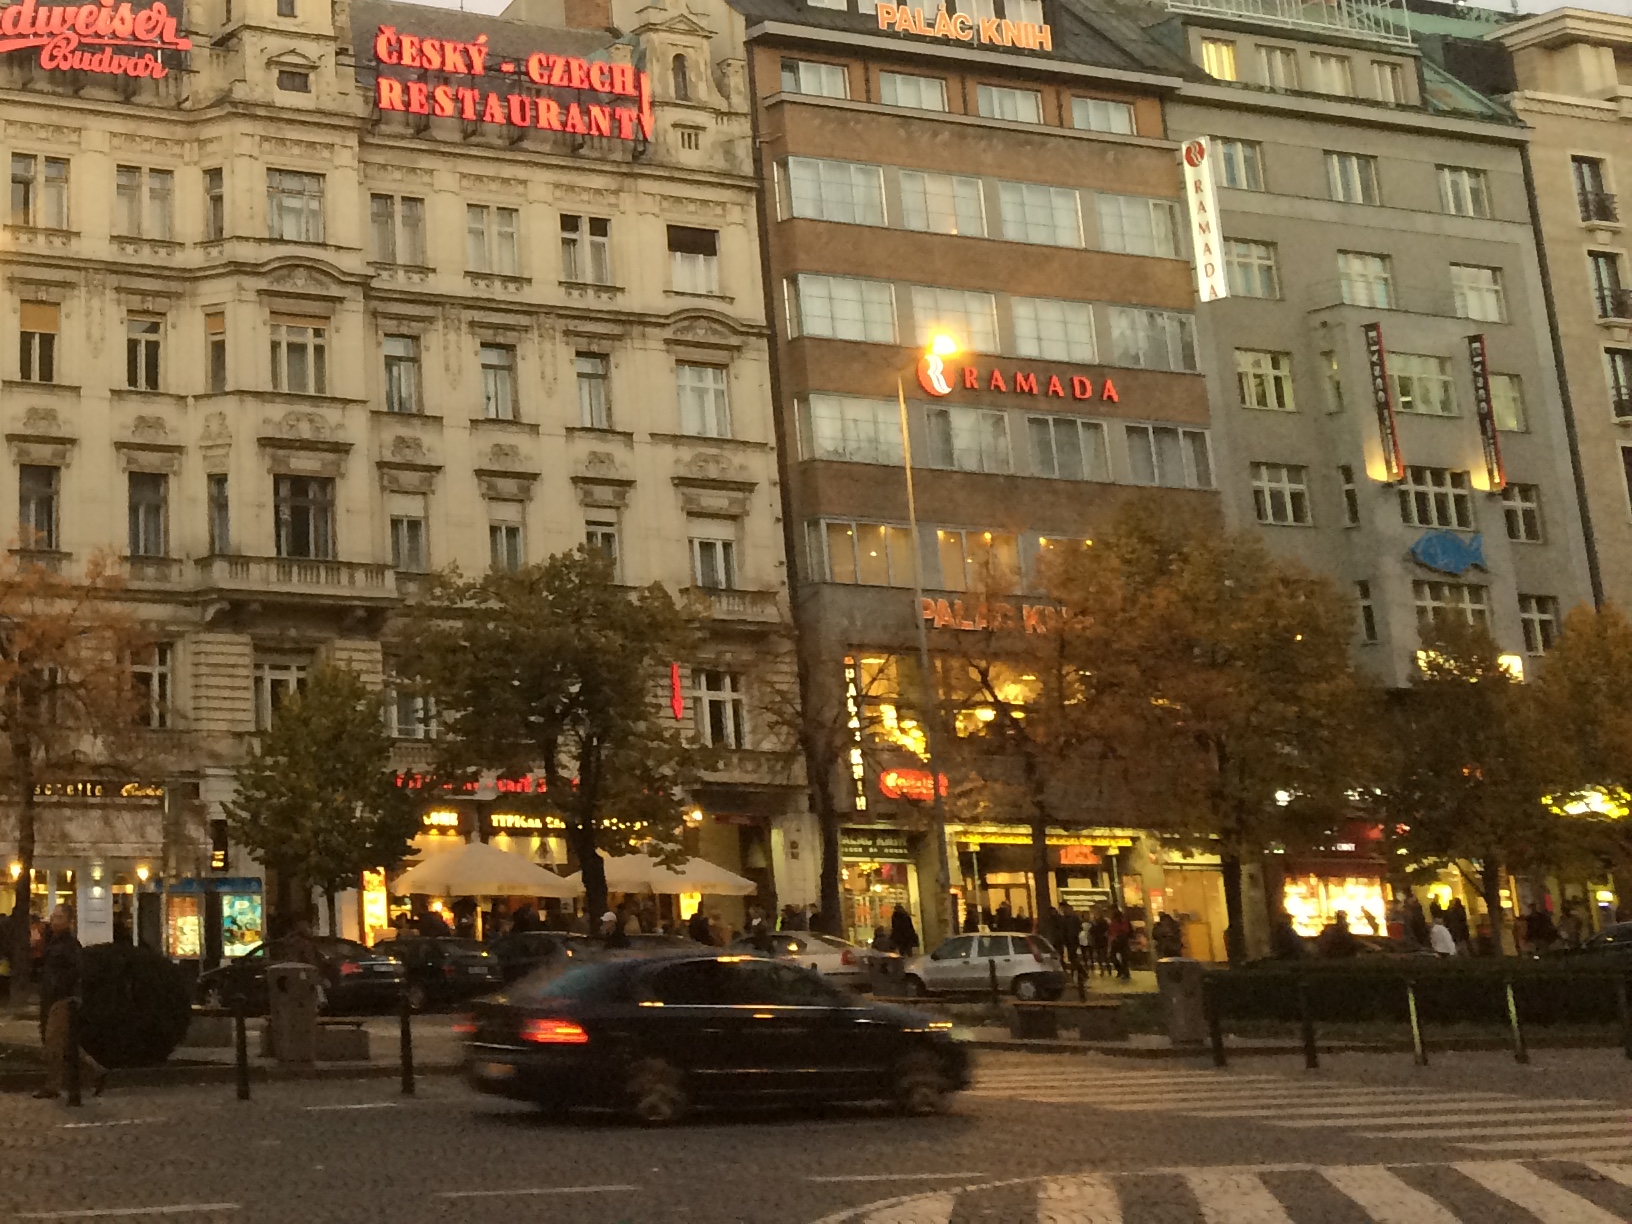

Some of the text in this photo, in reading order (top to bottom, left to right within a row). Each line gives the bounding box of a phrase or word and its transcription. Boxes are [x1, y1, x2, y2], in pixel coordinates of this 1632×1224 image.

[876, 2, 1053, 52] PALÁC KNIH
[39, 33, 169, 80] Budvar
[375, 24, 488, 76] ČESKÝ
[526, 52, 638, 97] CZECH
[377, 77, 637, 140] RESTAURANT
[1193, 178, 1218, 299] RAMADA
[962, 366, 1119, 403] RAMADA
